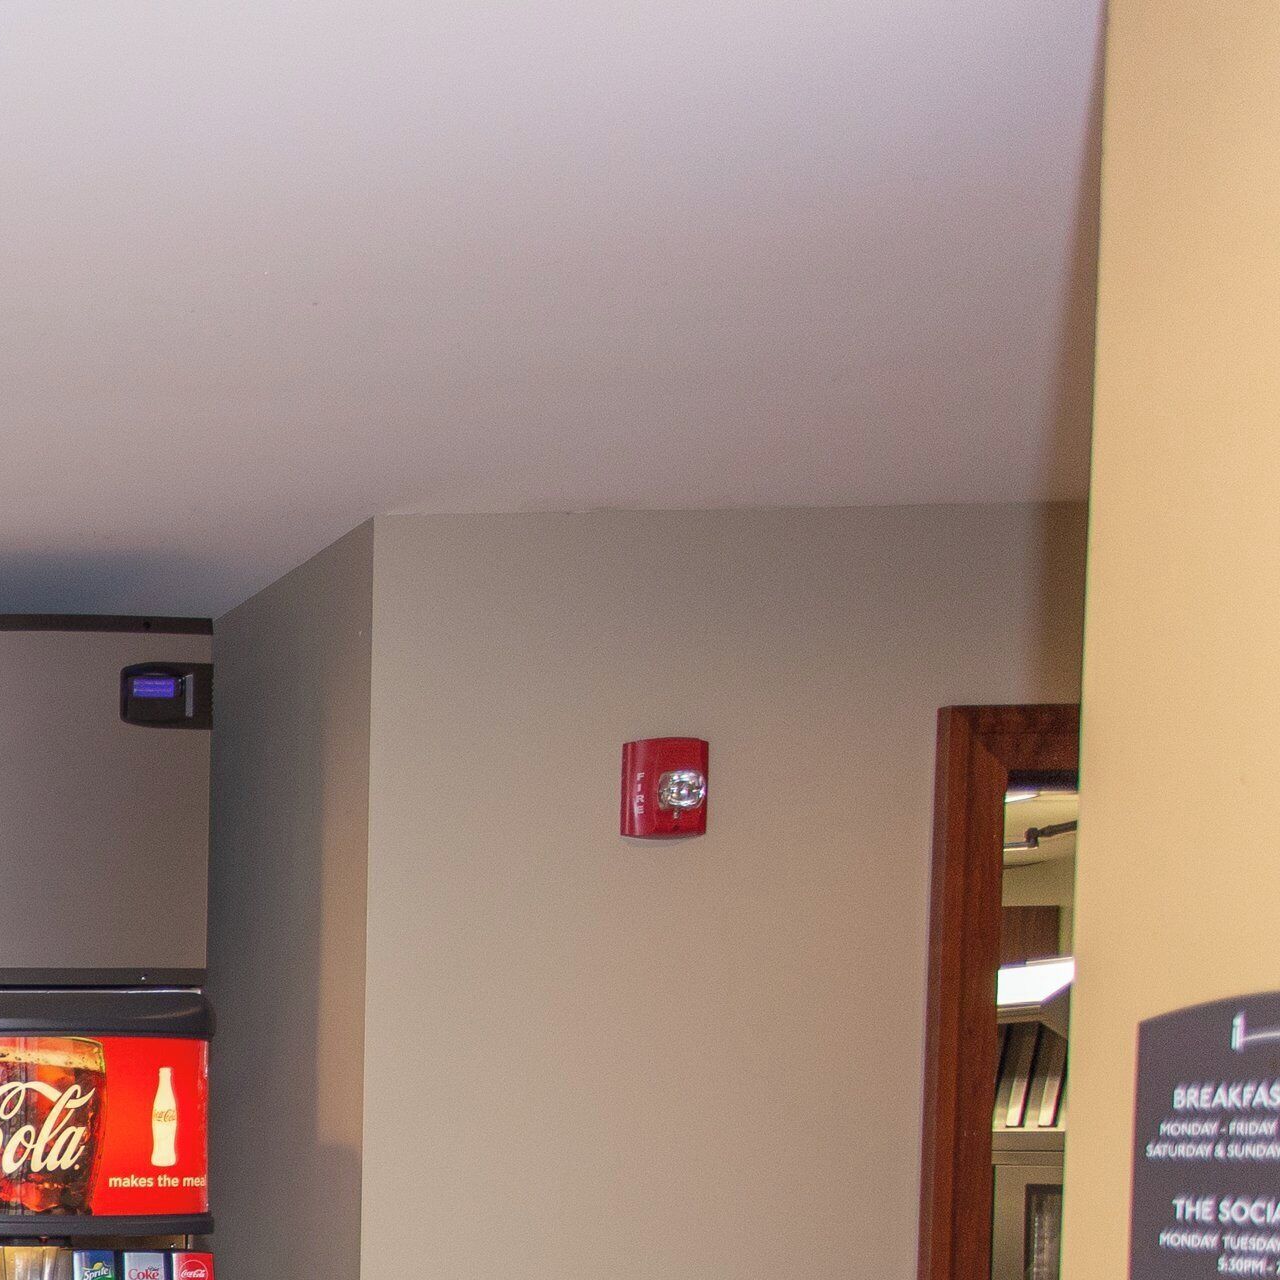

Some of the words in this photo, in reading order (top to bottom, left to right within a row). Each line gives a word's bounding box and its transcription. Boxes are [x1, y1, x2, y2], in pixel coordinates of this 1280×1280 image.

[635, 772, 645, 815] FIRE
[1159, 1120, 1219, 1137] MONDAY
[1228, 1119, 1278, 1136] FRIDAY
[1145, 1143, 1214, 1158] SATURDAY
[1214, 1143, 1226, 1157] &
[108, 1174, 154, 1188] makes
[157, 1174, 179, 1188] the
[1172, 1198, 1216, 1221] THE
[1159, 1231, 1218, 1248] MONDAY
[1217, 1256, 1266, 1273] 5:30PM
[128, 1268, 159, 1280] Coke
